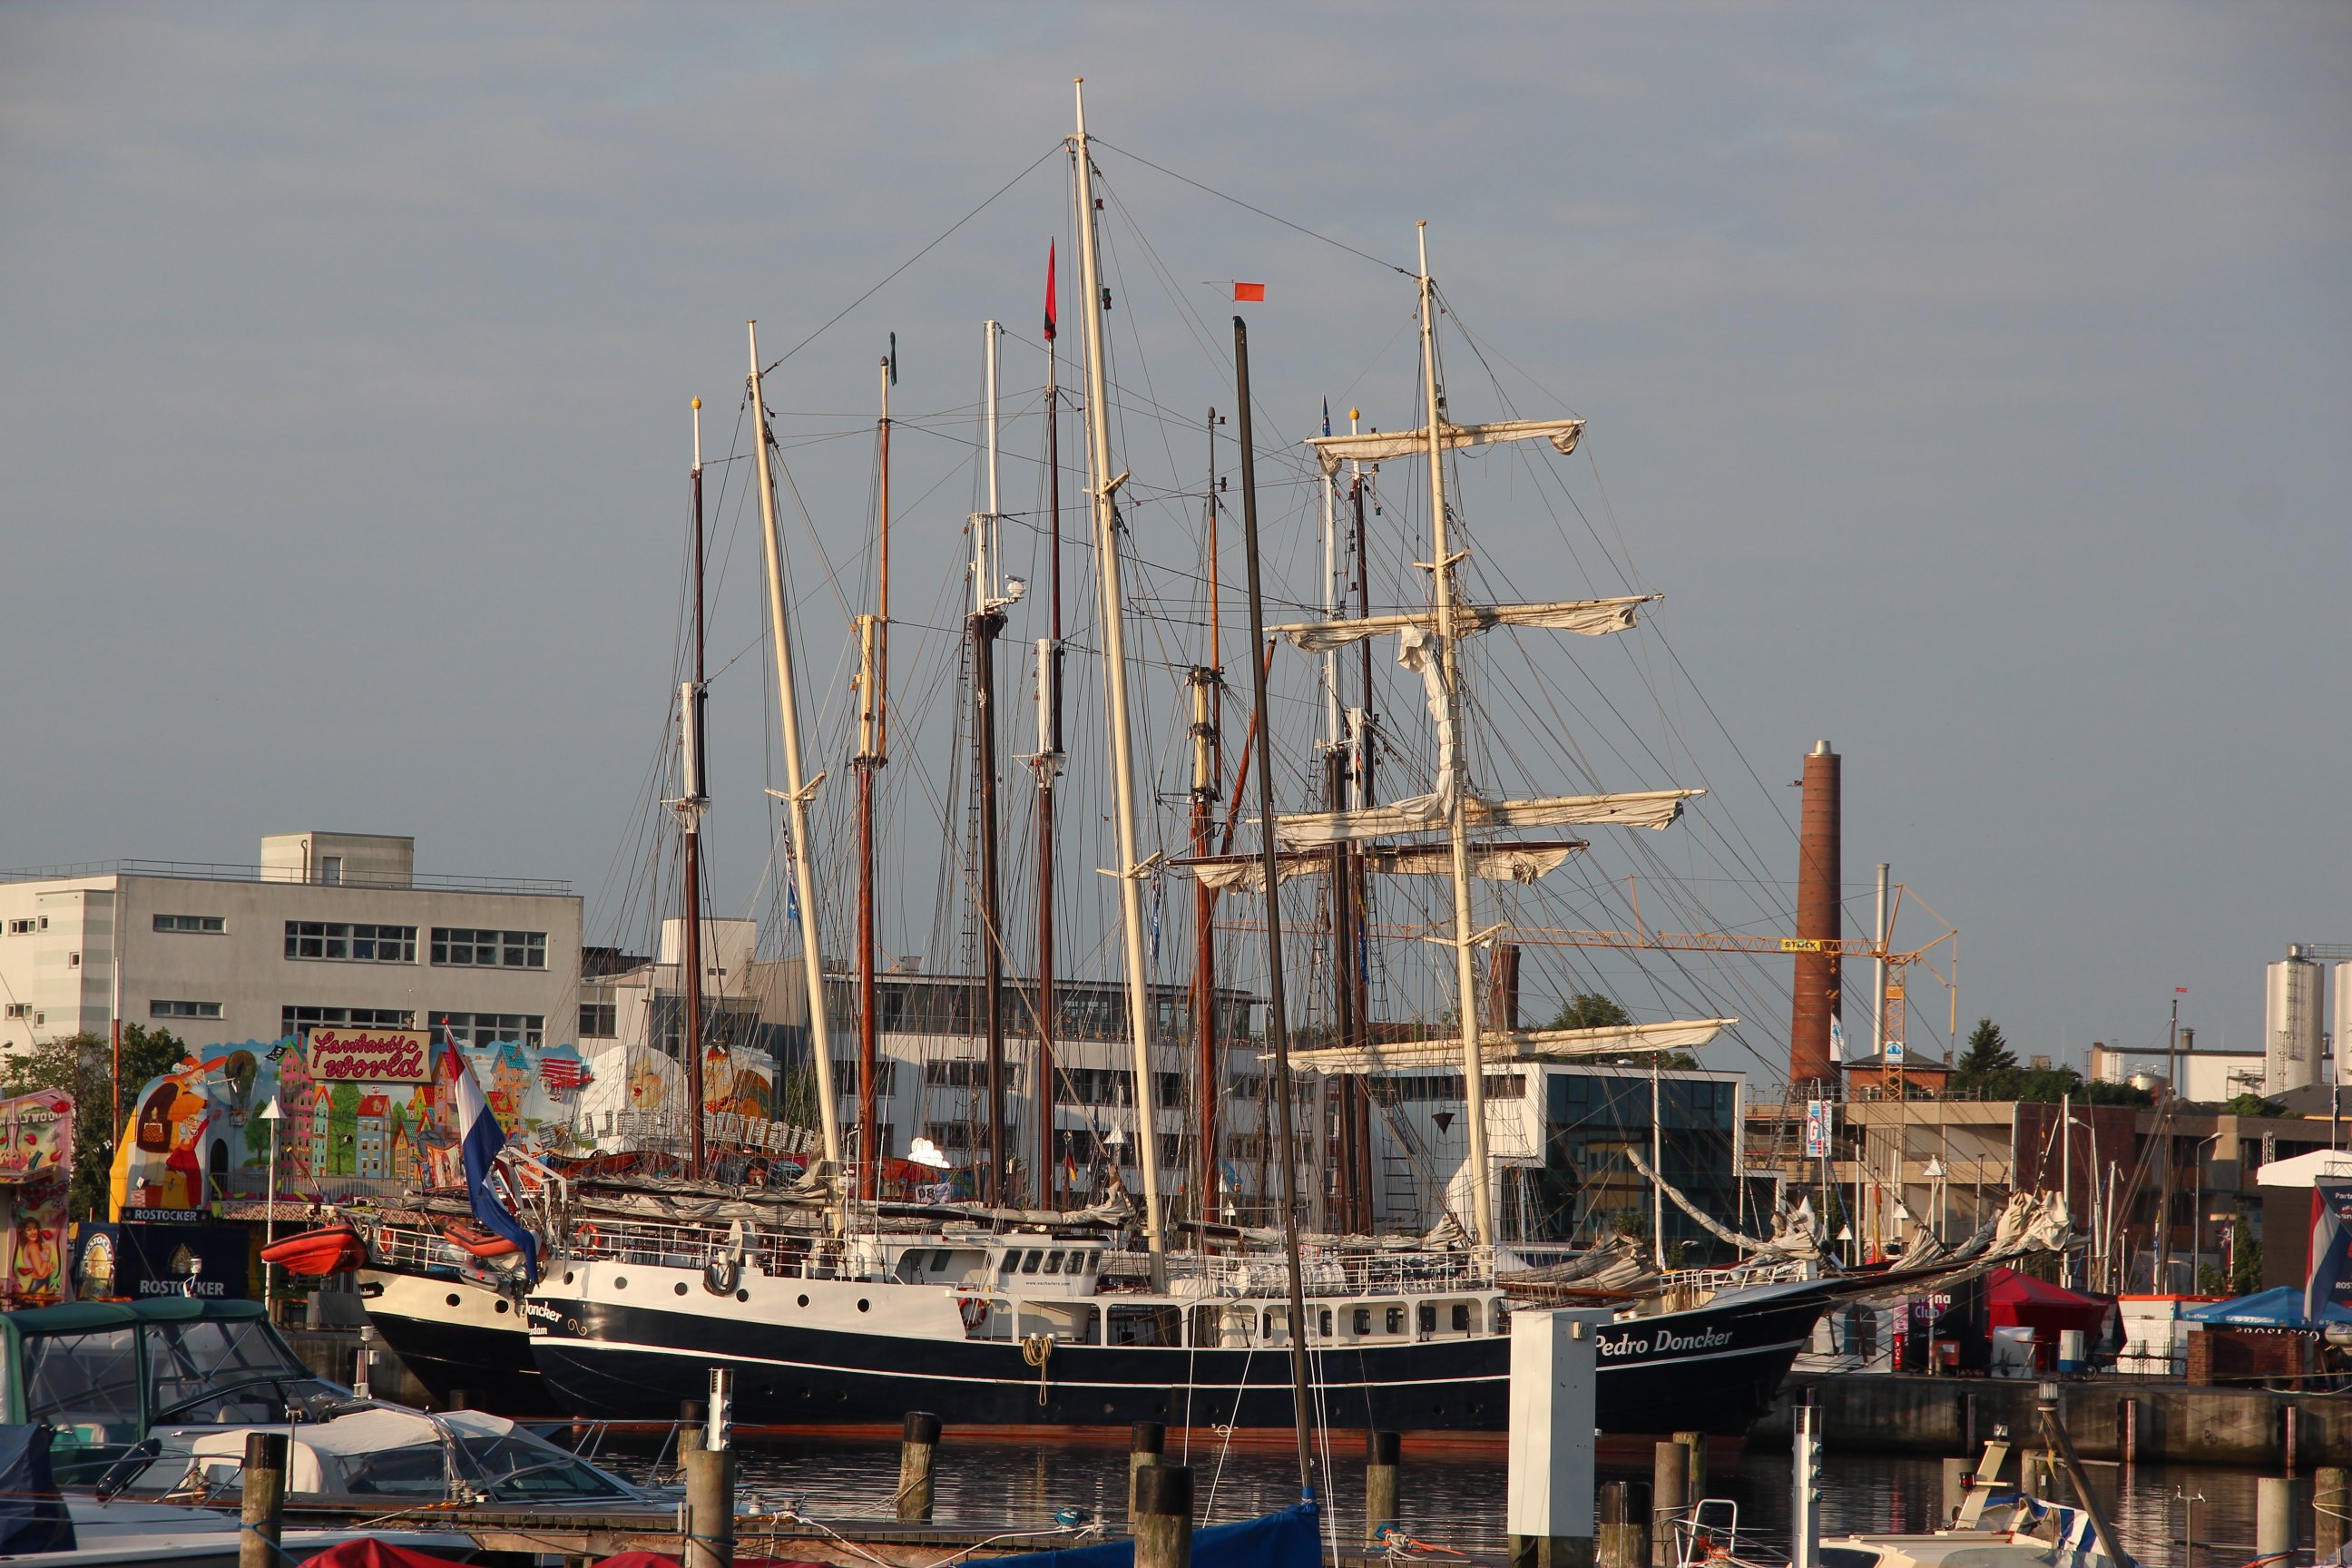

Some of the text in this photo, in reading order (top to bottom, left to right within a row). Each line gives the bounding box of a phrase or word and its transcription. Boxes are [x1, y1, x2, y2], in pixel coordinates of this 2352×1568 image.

[313, 1031, 419, 1068] fantastic
[324, 1051, 424, 1078] world
[134, 1209, 197, 1221] ROSTOCKER
[139, 1280, 225, 1296] ROSTOKER
[1915, 1305, 1941, 1318] Club
[1596, 1327, 1734, 1357] Pedro Doncker
